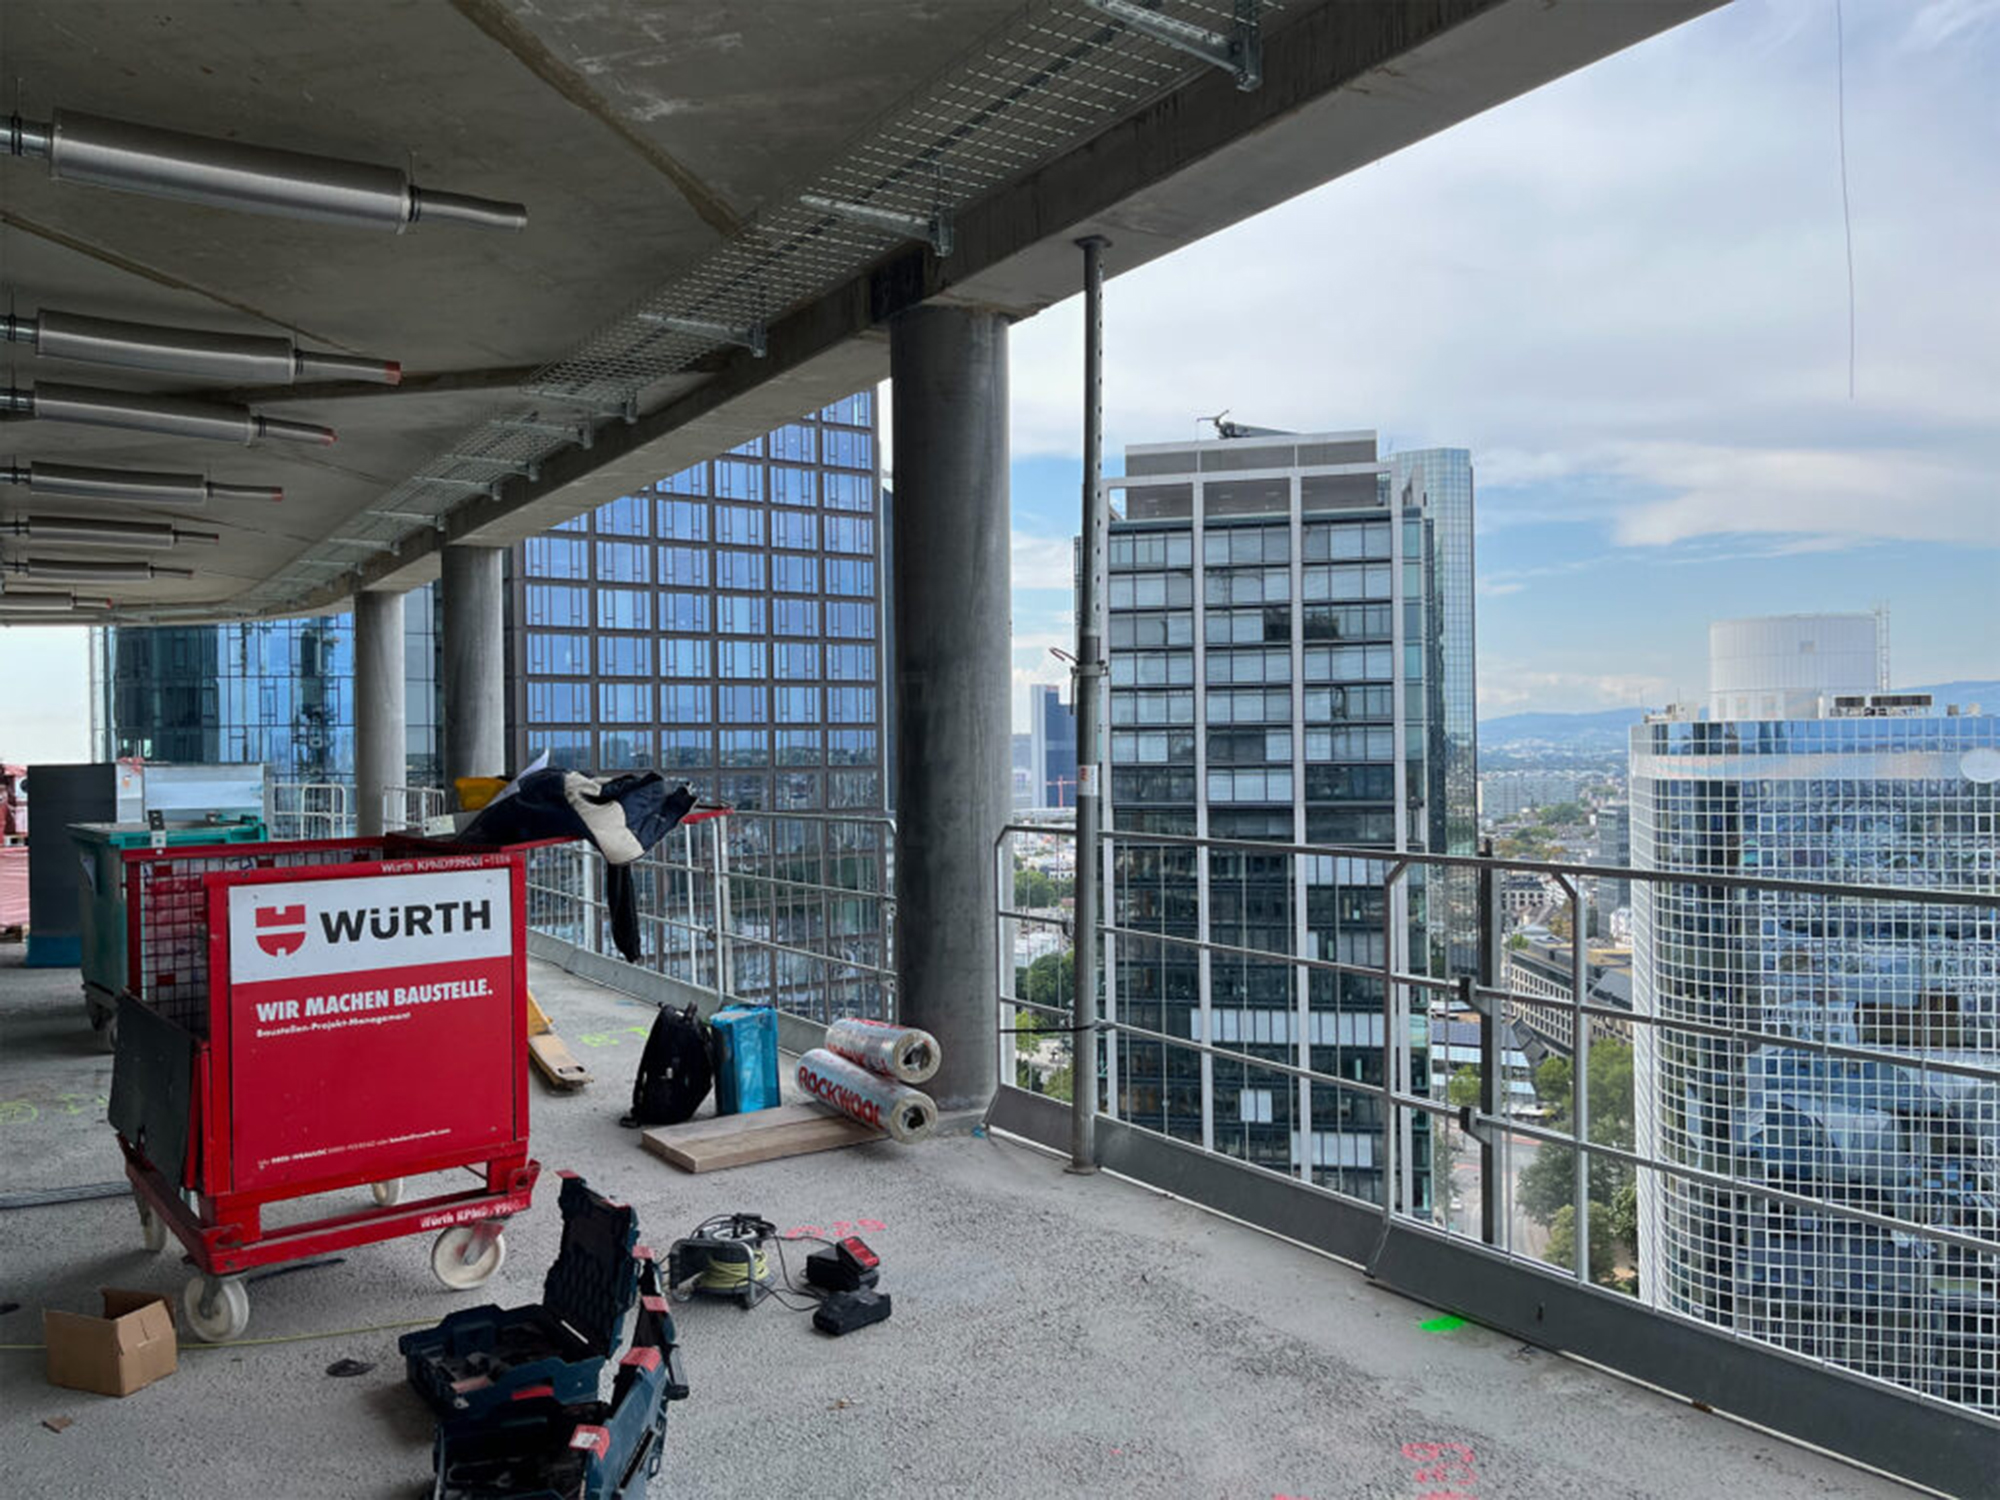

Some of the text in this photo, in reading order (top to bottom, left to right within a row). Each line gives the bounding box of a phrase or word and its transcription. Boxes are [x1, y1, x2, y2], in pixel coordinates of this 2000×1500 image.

[320, 900, 491, 944] WÜRTH
[256, 978, 493, 1023] WIR MACHEN BAUSTELLE.
[256, 1011, 412, 1038] Baustellen-Projekt-Management
[798, 1065, 888, 1131] ROCKWOOL
